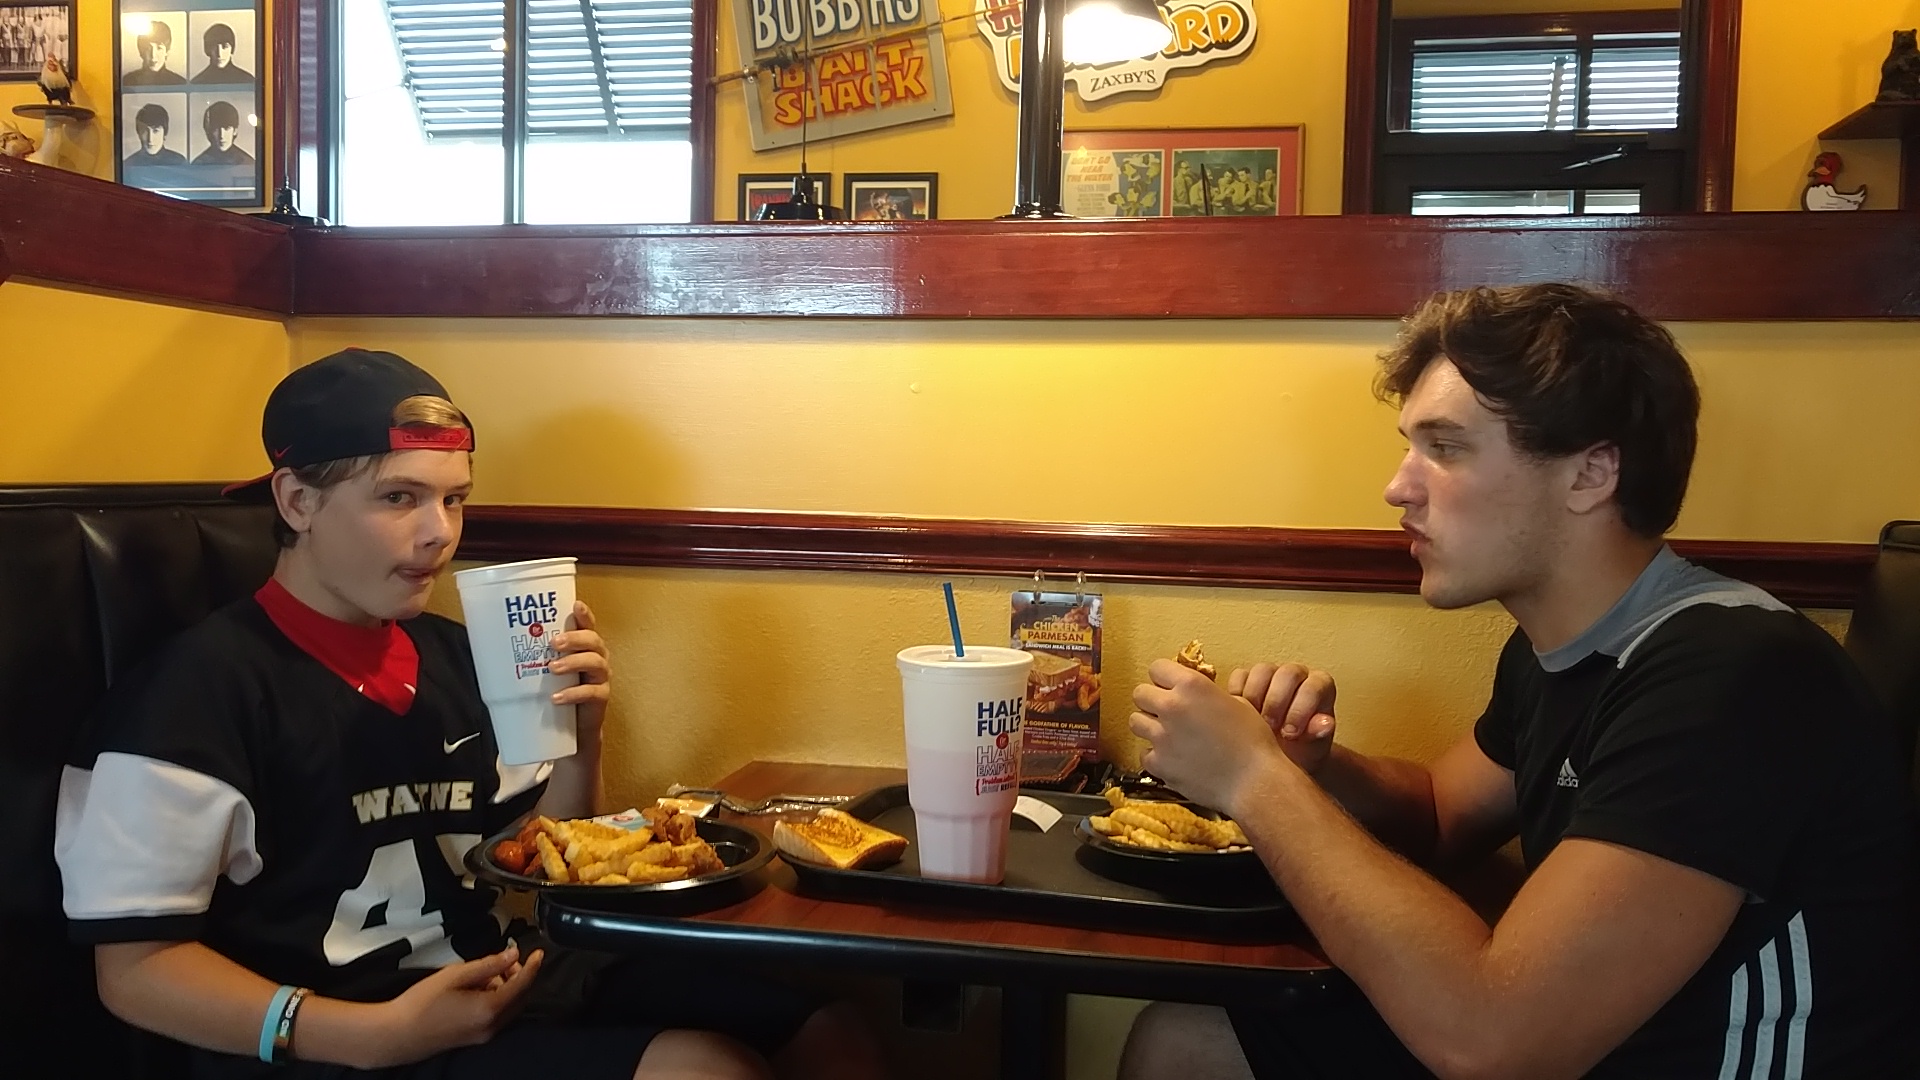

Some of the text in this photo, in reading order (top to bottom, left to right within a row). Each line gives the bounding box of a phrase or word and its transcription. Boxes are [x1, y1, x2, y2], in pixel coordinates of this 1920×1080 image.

[781, 38, 913, 89] BAIT
[775, 56, 927, 126] SHACK
[1090, 69, 1157, 93] ZAXBY'S
[505, 591, 557, 613] HALF
[508, 607, 558, 628] FULL?
[1034, 621, 1079, 631] CHICKEN
[1027, 630, 1084, 641] PARMESAN
[977, 697, 1022, 719] HALF
[977, 715, 1021, 737] FULL?
[977, 740, 1020, 764] HALF
